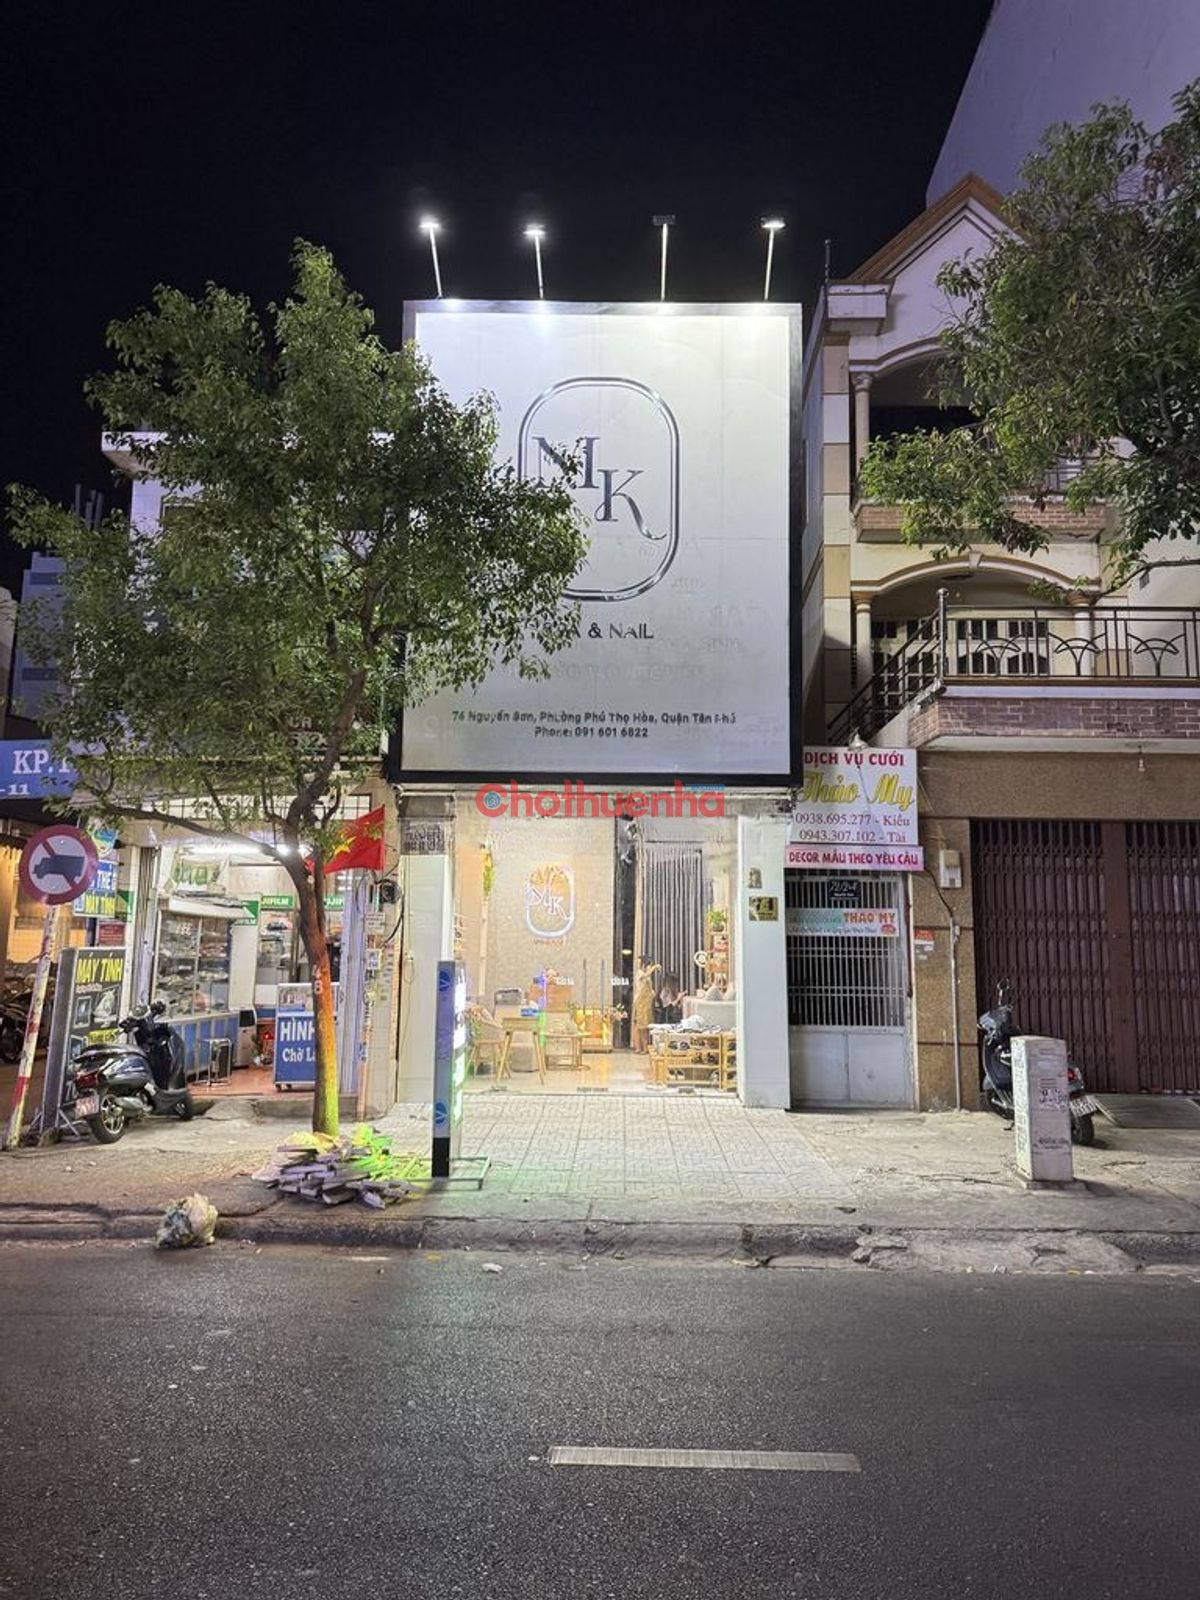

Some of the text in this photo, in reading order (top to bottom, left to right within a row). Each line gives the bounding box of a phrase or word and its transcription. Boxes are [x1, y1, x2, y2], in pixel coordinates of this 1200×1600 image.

[588, 623, 603, 638] &
[609, 712, 629, 724] Thọ
[575, 727, 594, 737] 091
[599, 727, 616, 737] 601
[621, 727, 648, 737] 6822
[805, 750, 904, 769] DỊCH VỤ CƯỚI
[795, 813, 871, 825] 0938.695.277
[800, 830, 876, 842] 0943.307.102
[789, 852, 819, 863] DECOR
[848, 853, 873, 864] THEO
